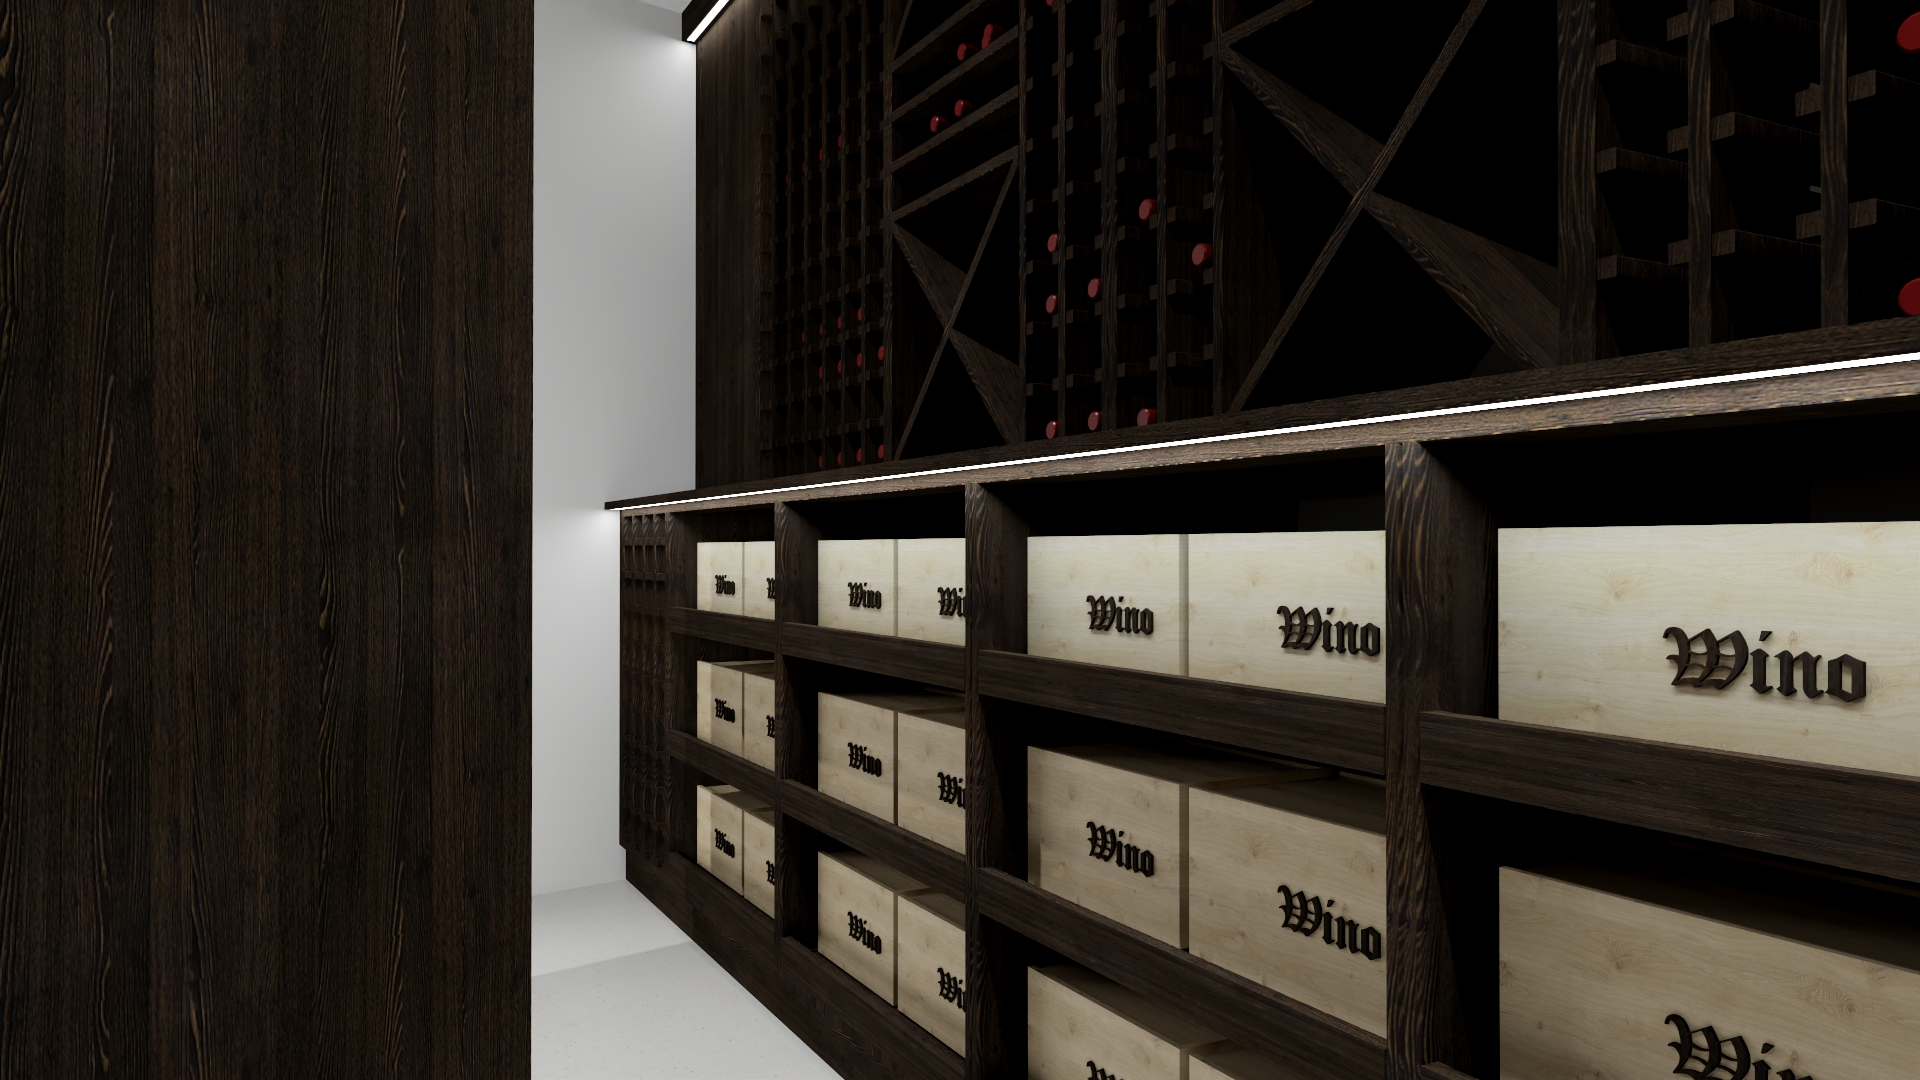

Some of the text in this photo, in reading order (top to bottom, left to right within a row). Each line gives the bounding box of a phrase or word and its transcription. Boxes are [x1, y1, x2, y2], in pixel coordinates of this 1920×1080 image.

[714, 574, 736, 596] Wino
[847, 581, 882, 610] Wino
[937, 586, 966, 618] Wi
[1085, 595, 1155, 636] Wino
[1276, 605, 1381, 657] Wino
[1662, 626, 1867, 703] Wino
[714, 697, 736, 724] Wino
[847, 741, 882, 778] Wino
[936, 771, 966, 810] Wi
[714, 828, 736, 859] Wino
[1086, 821, 1155, 878] Wino
[847, 911, 882, 955] Wino
[1277, 884, 1382, 961] Wino
[936, 967, 966, 1013] Wi
[1664, 1013, 1814, 1080] Wi
